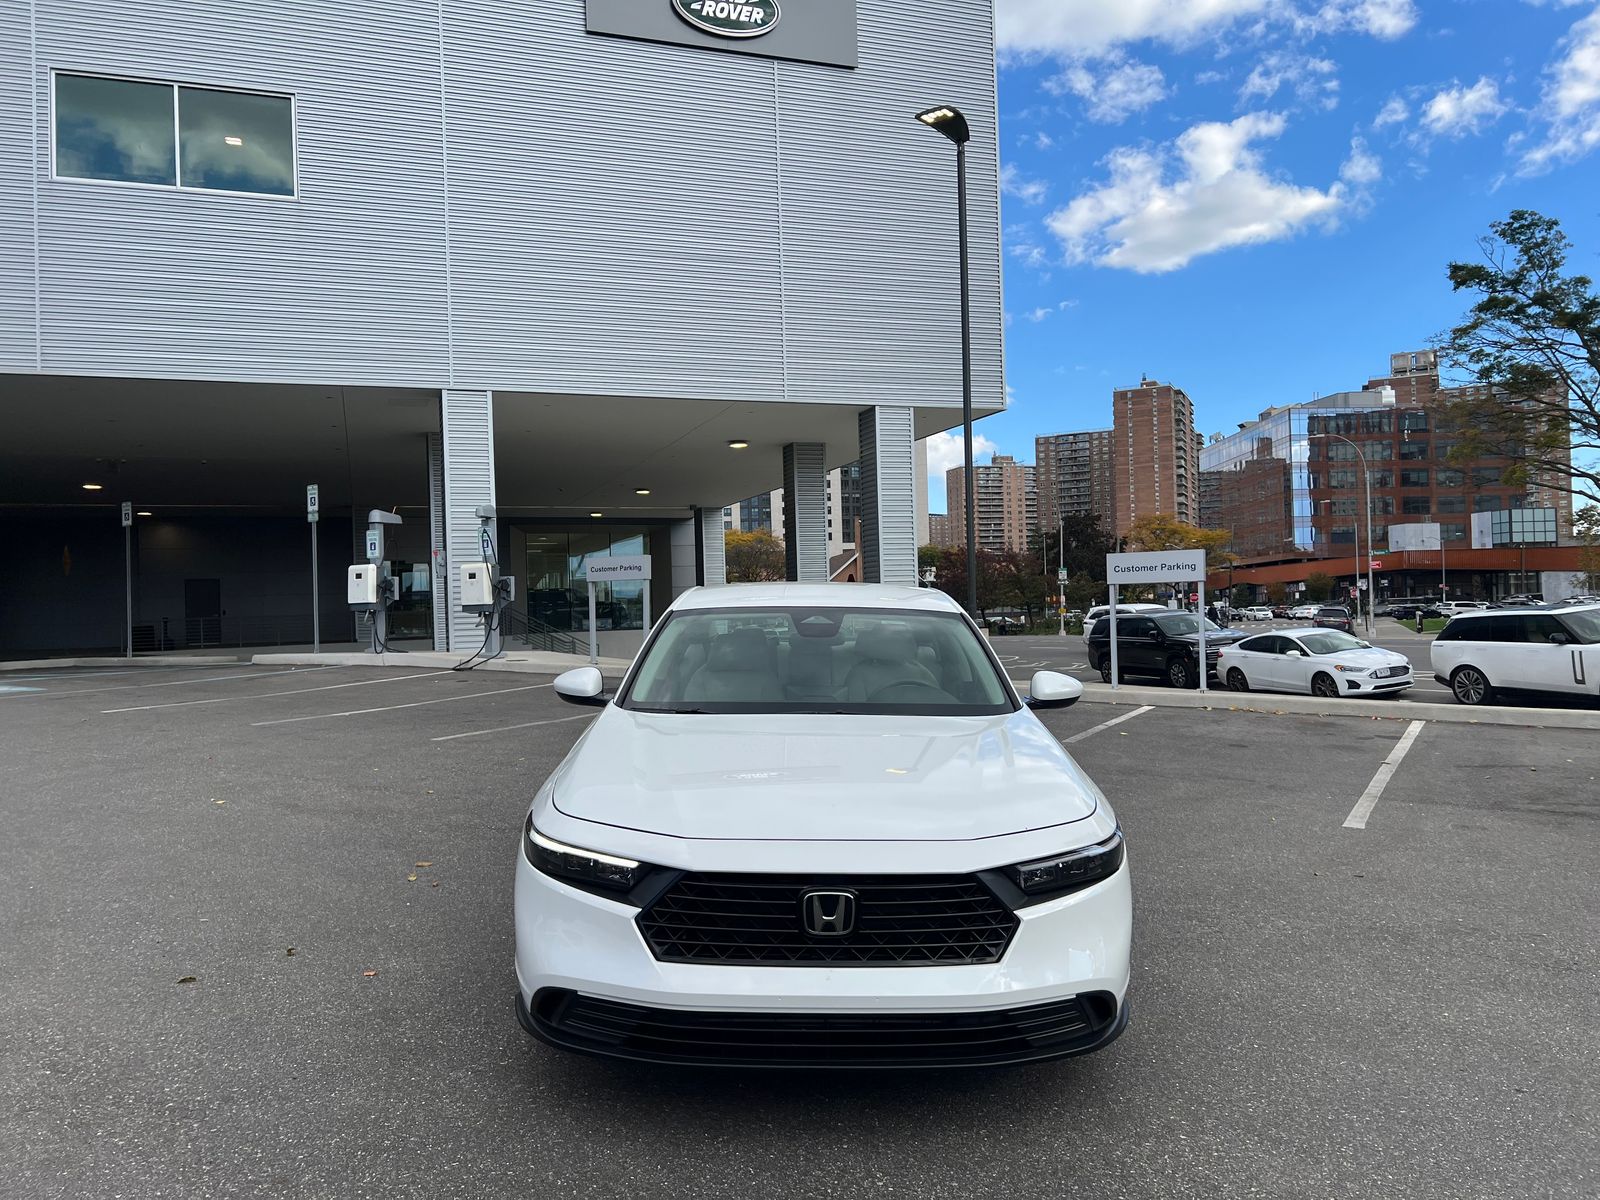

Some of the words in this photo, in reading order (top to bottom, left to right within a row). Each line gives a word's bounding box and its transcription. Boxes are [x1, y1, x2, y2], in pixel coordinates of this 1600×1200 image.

[702, 1, 764, 24] ROVER
[620, 564, 642, 572] Parking
[1113, 564, 1158, 573] Customer
[1160, 562, 1197, 572] Parking
